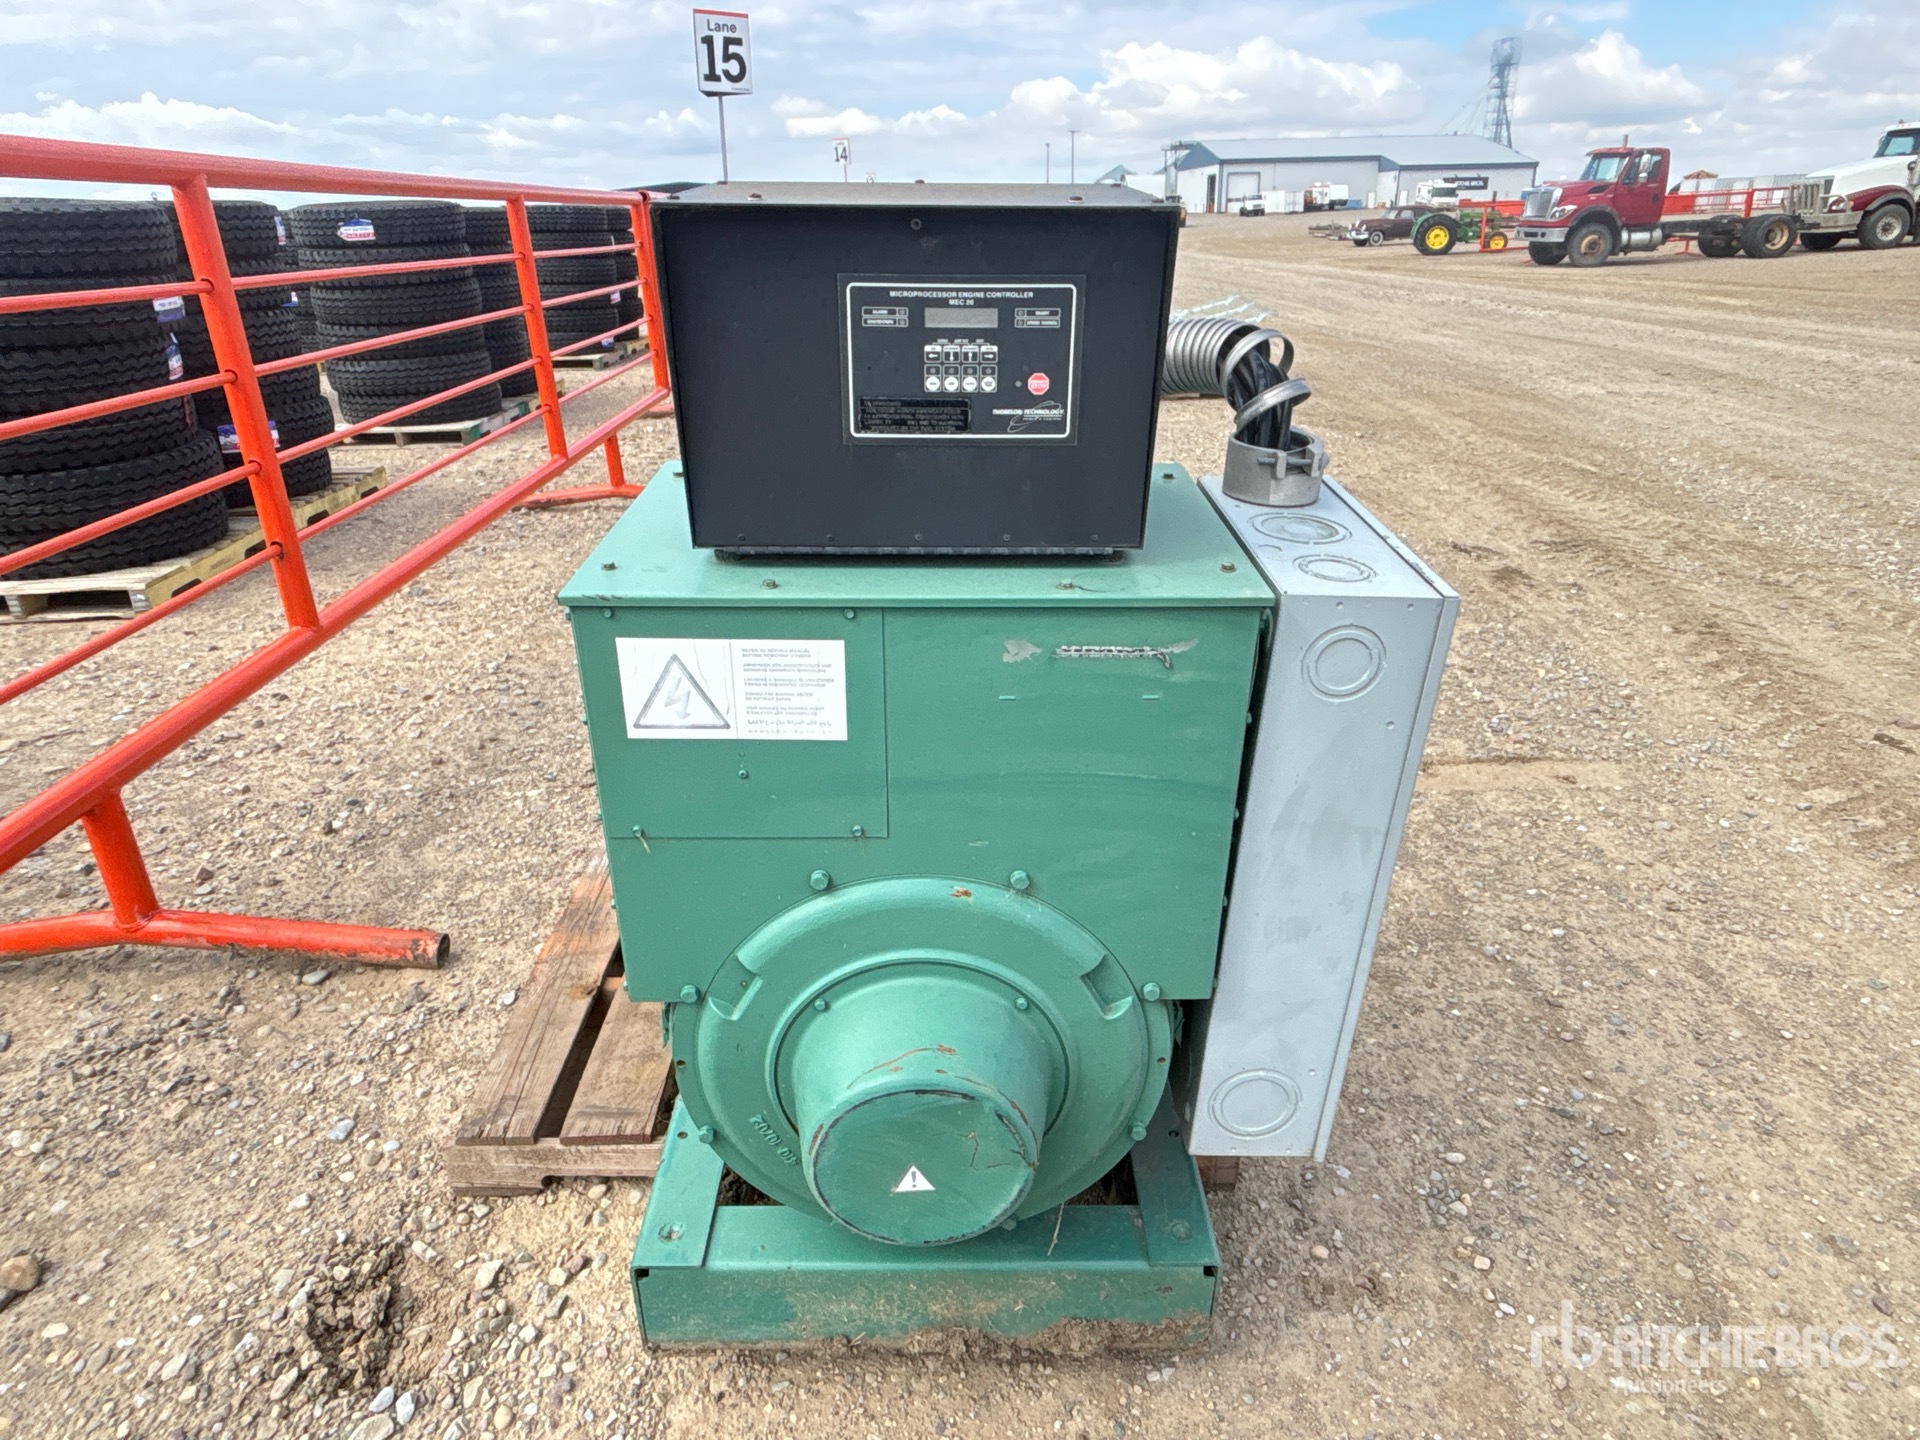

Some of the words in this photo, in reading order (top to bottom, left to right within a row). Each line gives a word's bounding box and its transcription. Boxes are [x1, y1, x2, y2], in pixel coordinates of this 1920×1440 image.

[707, 18, 737, 33] Lane
[700, 35, 747, 83] 15
[833, 146, 848, 162] 14
[889, 290, 957, 298] MICROPROCESSOR
[958, 290, 985, 298] ENGINE
